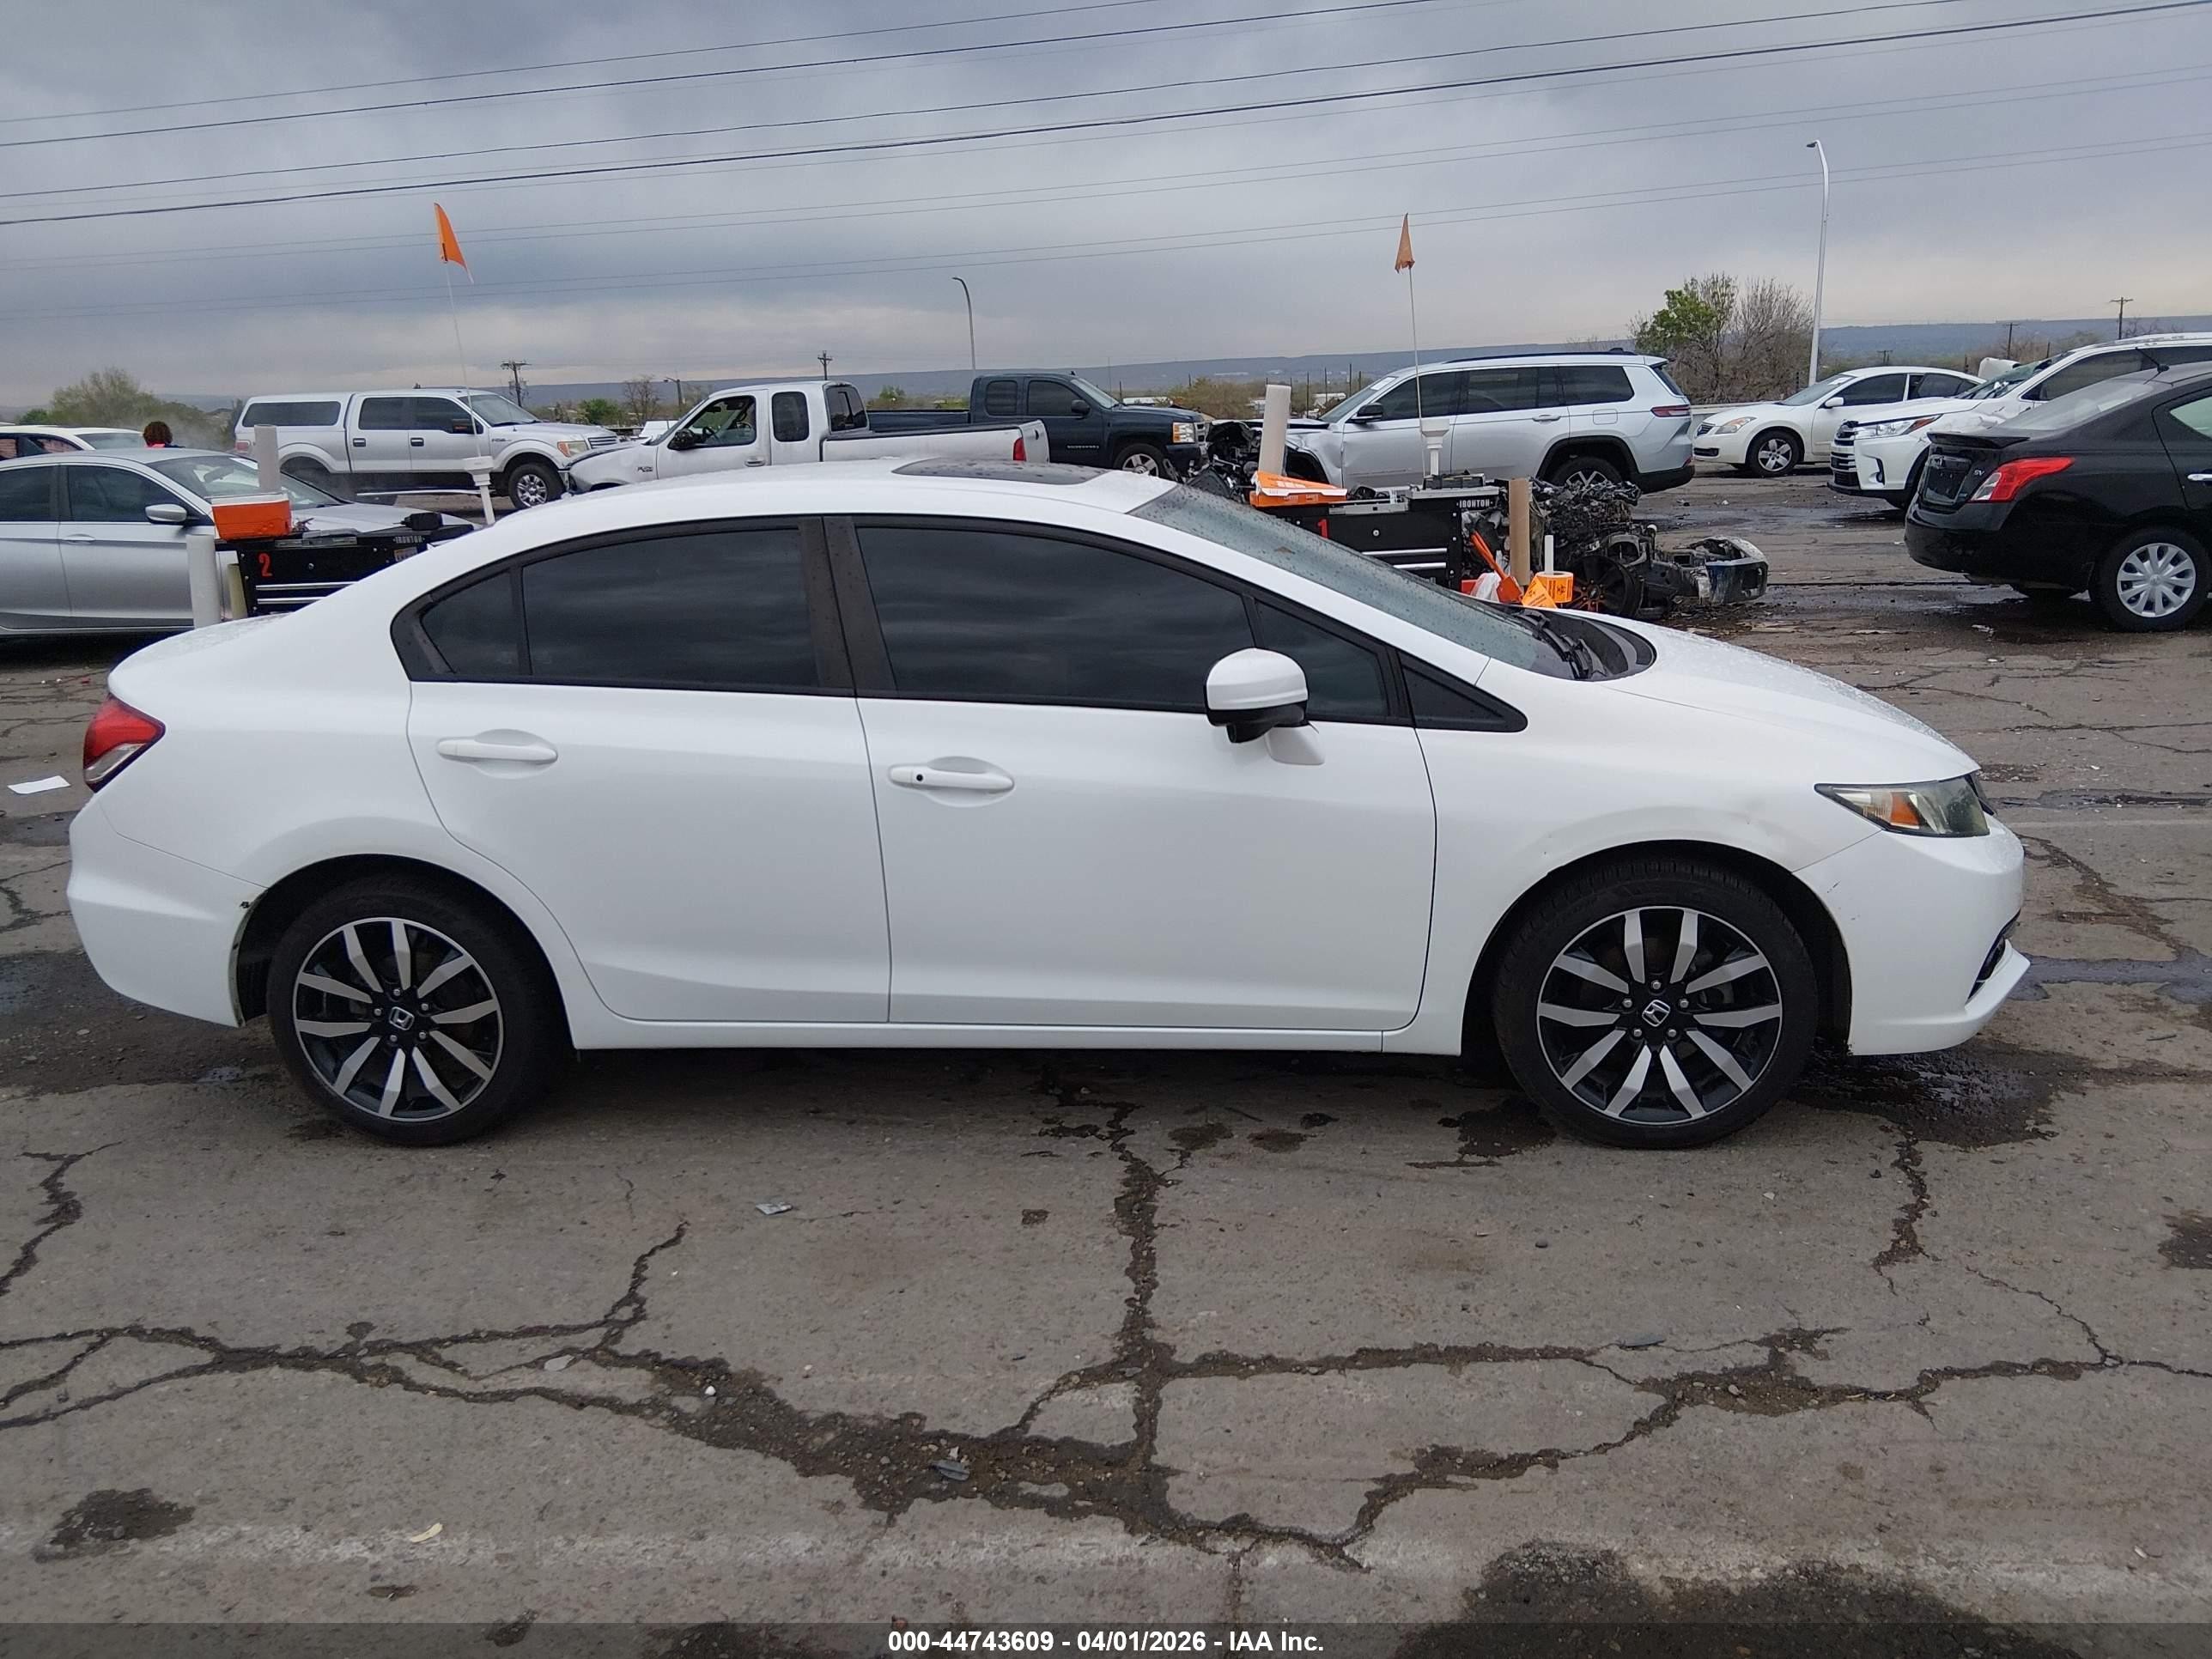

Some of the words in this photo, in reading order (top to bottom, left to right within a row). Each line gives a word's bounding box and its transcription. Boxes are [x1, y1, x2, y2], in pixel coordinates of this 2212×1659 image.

[1459, 499, 1490, 508] IRONTON
[1317, 518, 1329, 538] 1
[258, 552, 273, 577] 2
